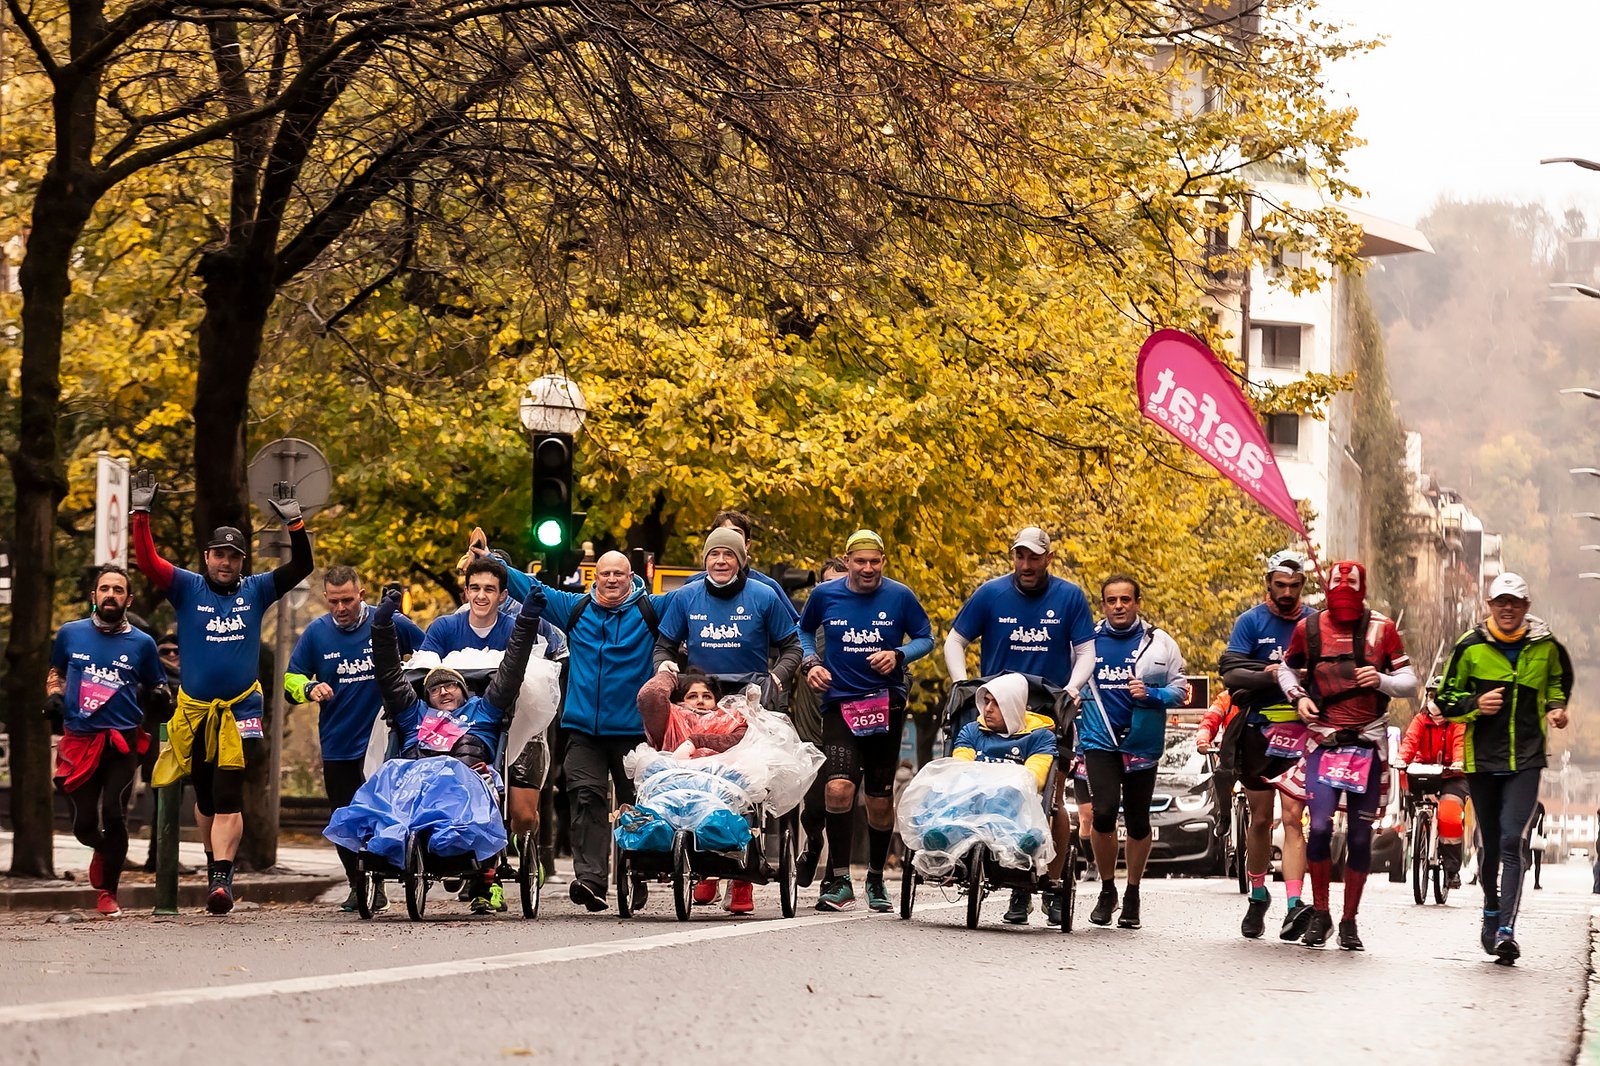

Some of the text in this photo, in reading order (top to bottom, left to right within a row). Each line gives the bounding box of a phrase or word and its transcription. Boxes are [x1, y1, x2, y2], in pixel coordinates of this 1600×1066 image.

[852, 712, 885, 727] 2629
[1269, 734, 1299, 749] 2627
[1325, 766, 1360, 782] 2634
